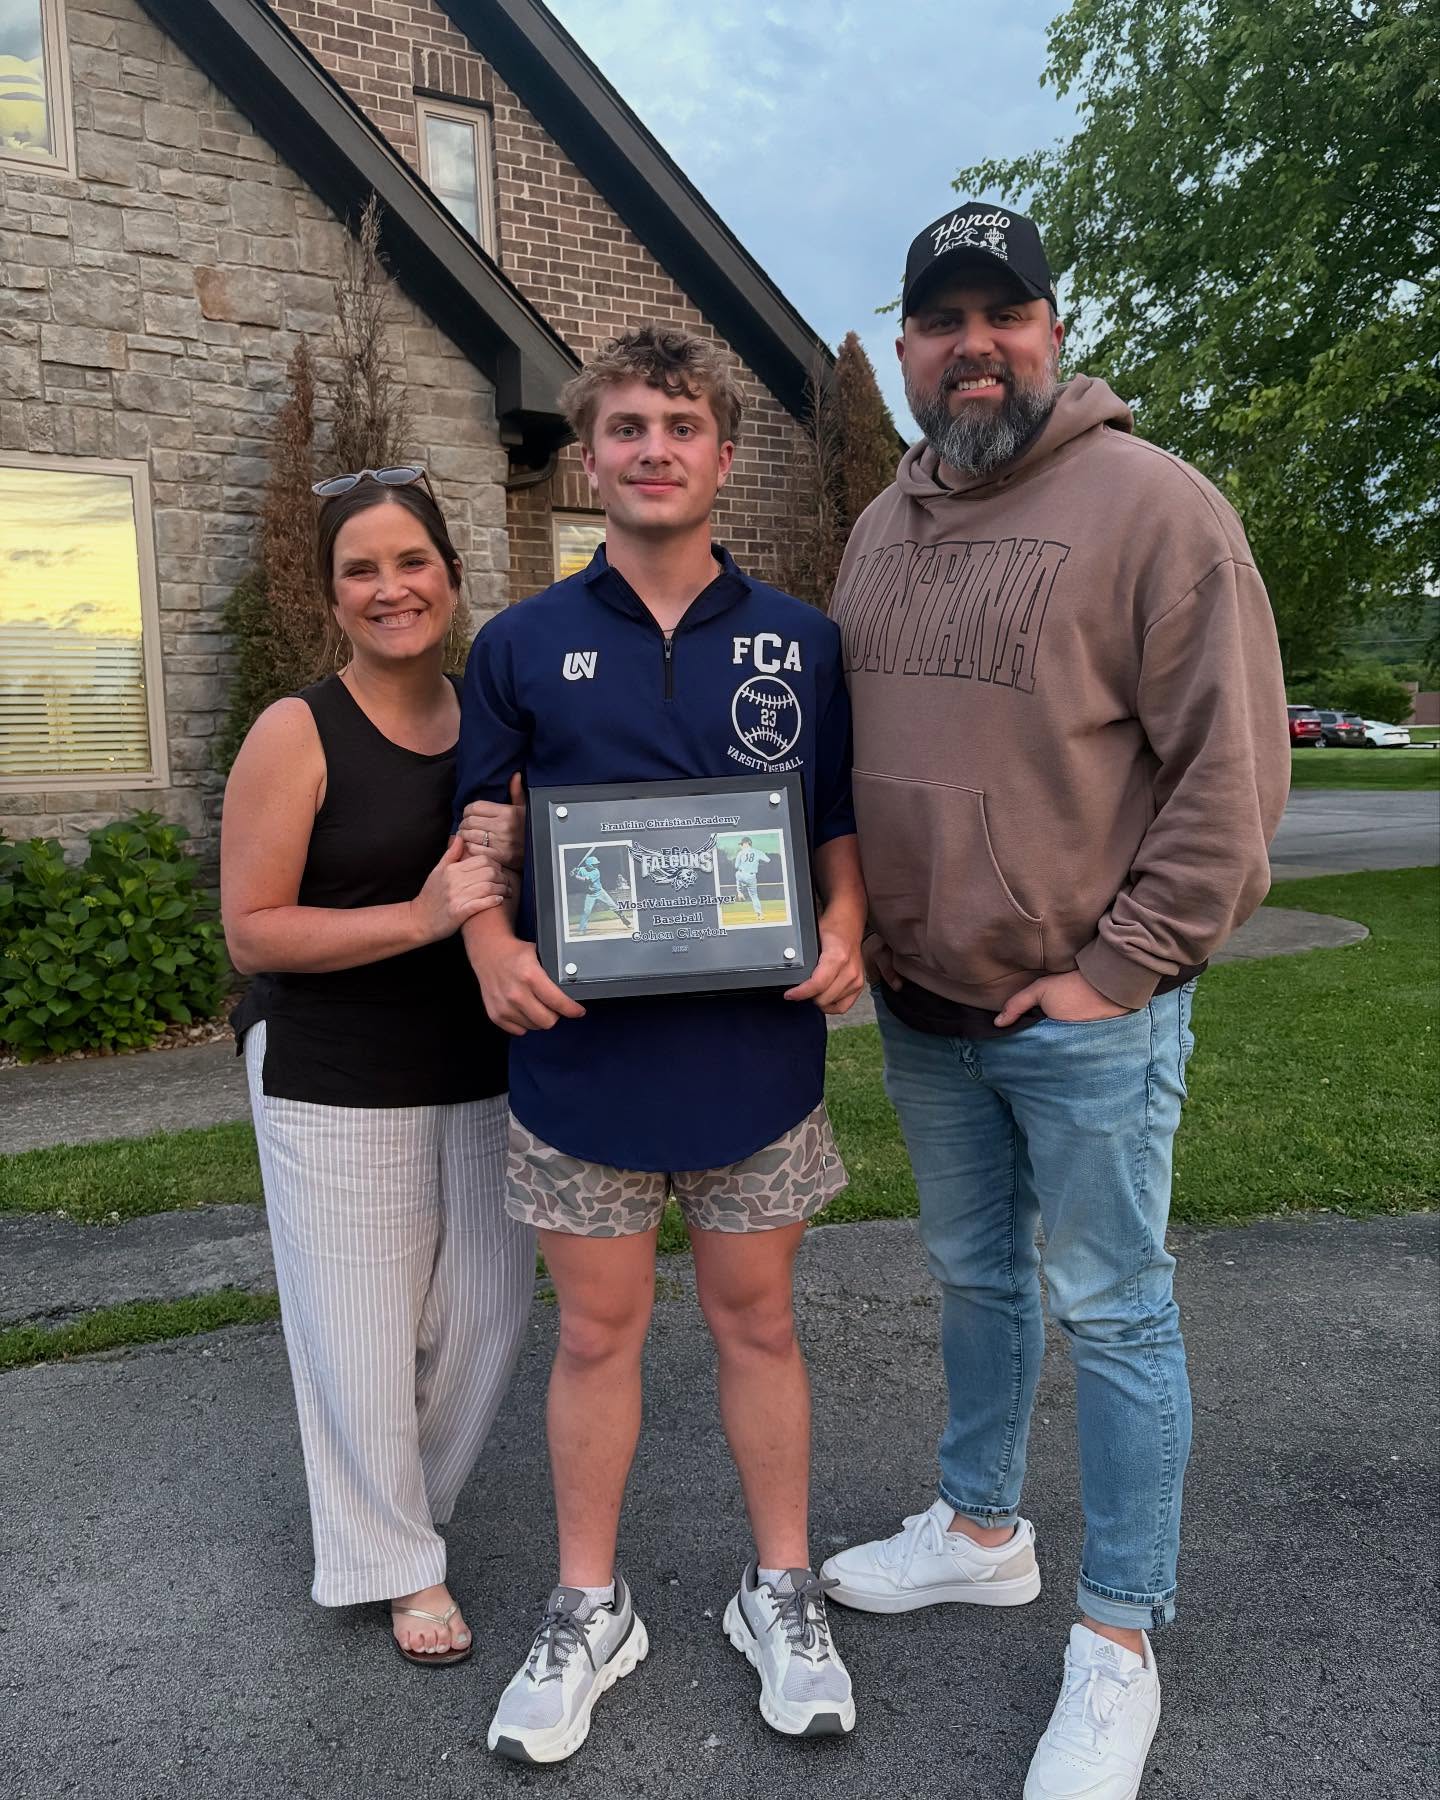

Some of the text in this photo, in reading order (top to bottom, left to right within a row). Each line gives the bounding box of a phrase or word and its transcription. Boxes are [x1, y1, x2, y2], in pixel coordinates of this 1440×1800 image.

[930, 210, 1011, 251] Hondo
[732, 632, 802, 674] FCA
[760, 708, 777, 728] 23
[727, 744, 767, 772] VARSITY
[600, 815, 740, 832] Franklin Christian Academy
[641, 851, 714, 878] FALCONS
[617, 894, 736, 910] Most Valuable Player
[653, 912, 704, 926] Baseball
[632, 926, 728, 942] Cohen Clayton
